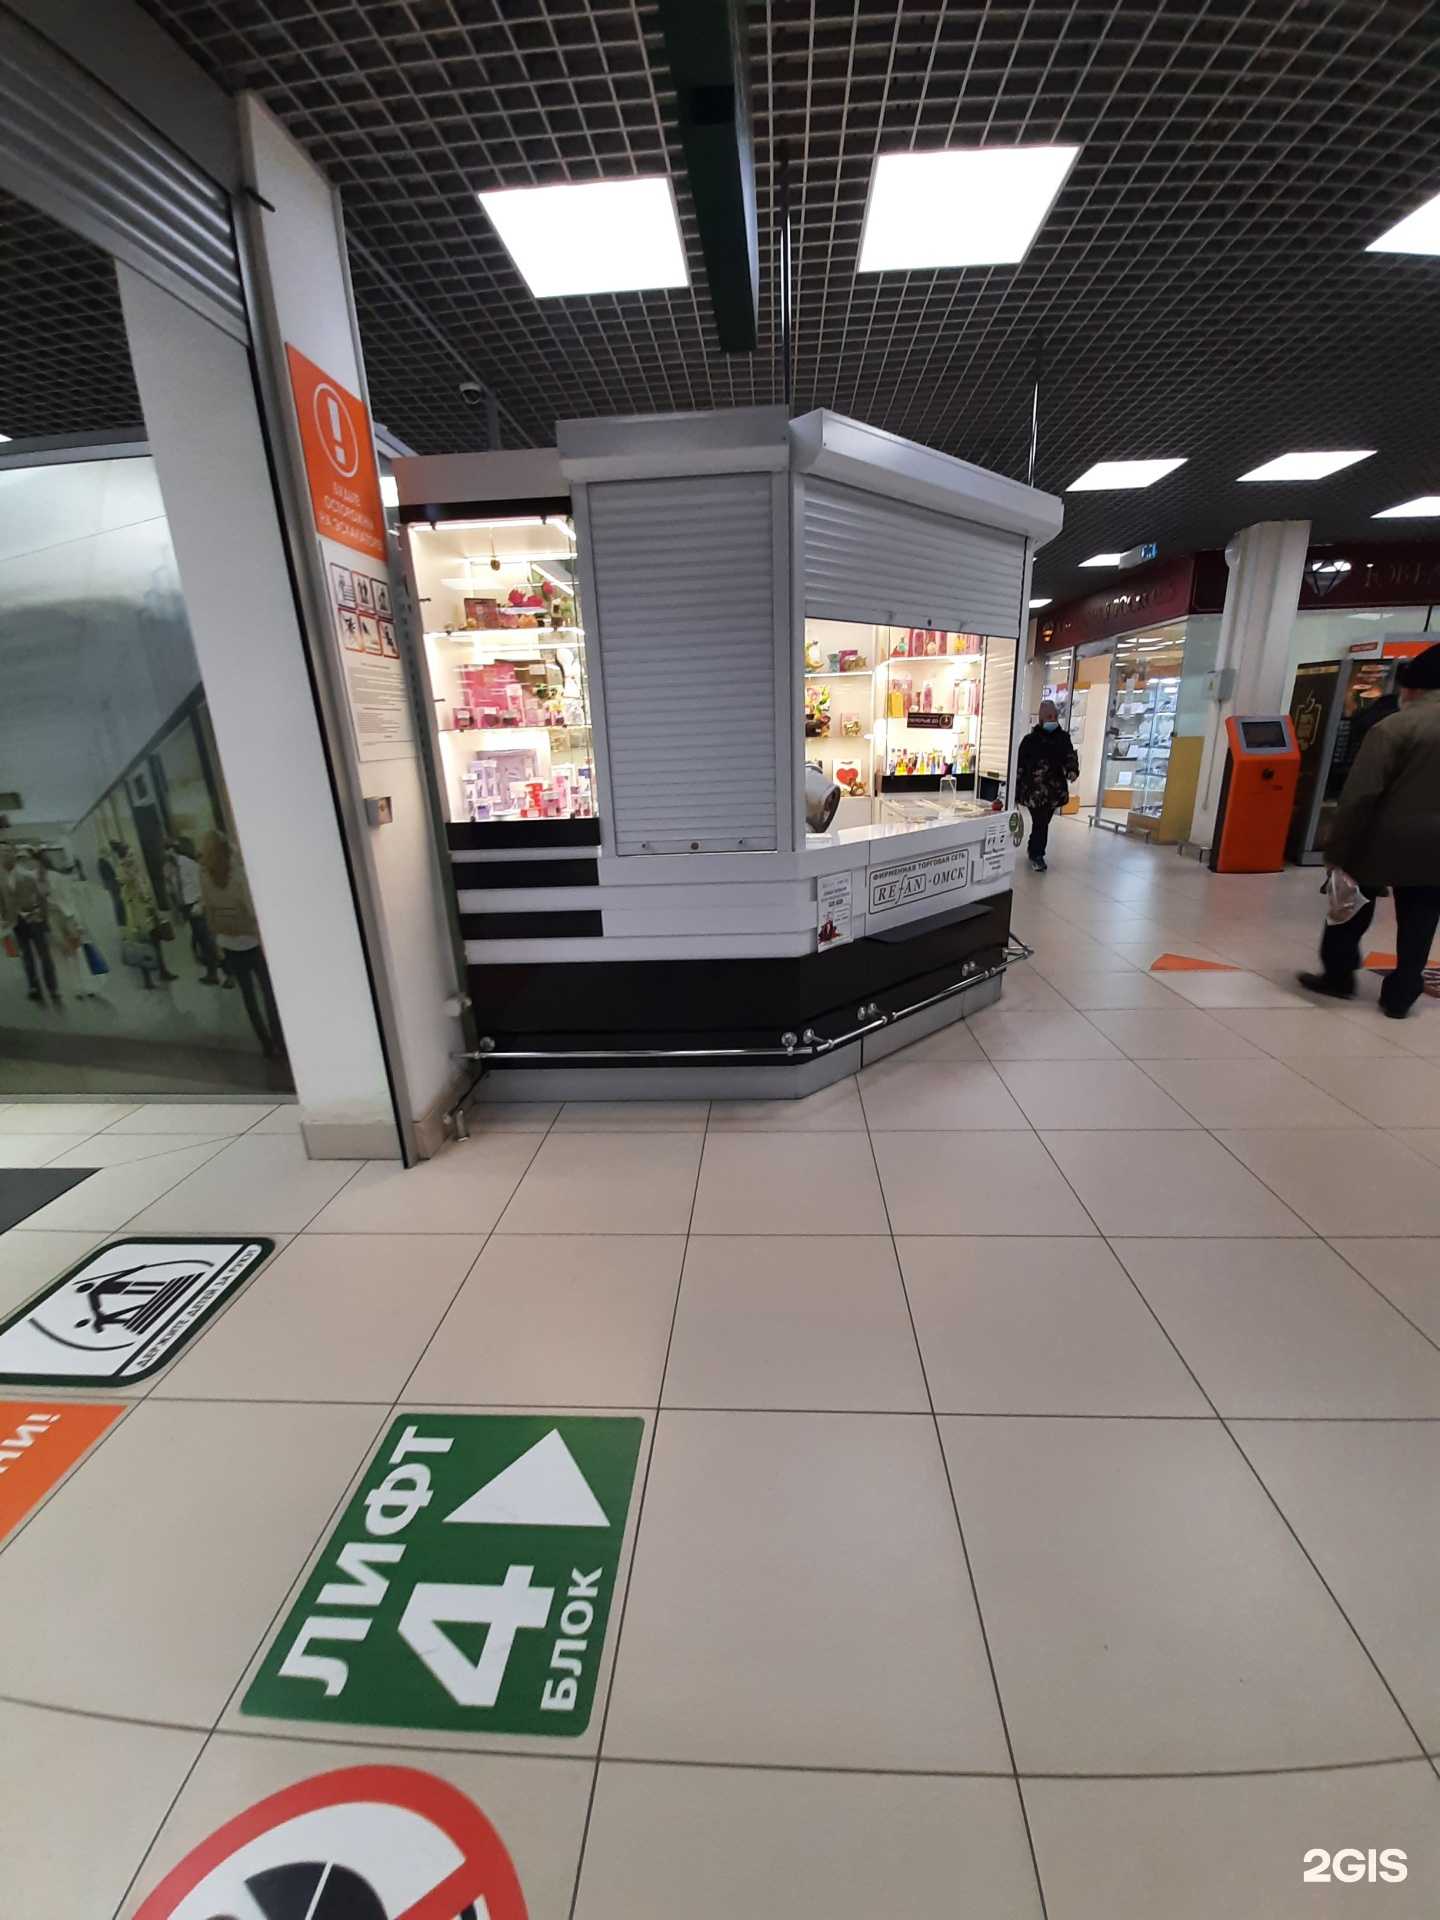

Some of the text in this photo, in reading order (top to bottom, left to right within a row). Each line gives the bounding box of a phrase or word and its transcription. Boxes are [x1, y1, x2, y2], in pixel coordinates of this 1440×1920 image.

[277, 1425, 455, 1697] ЛИФТ
[397, 1564, 555, 1707] 4
[540, 1567, 603, 1712] БЛОК
